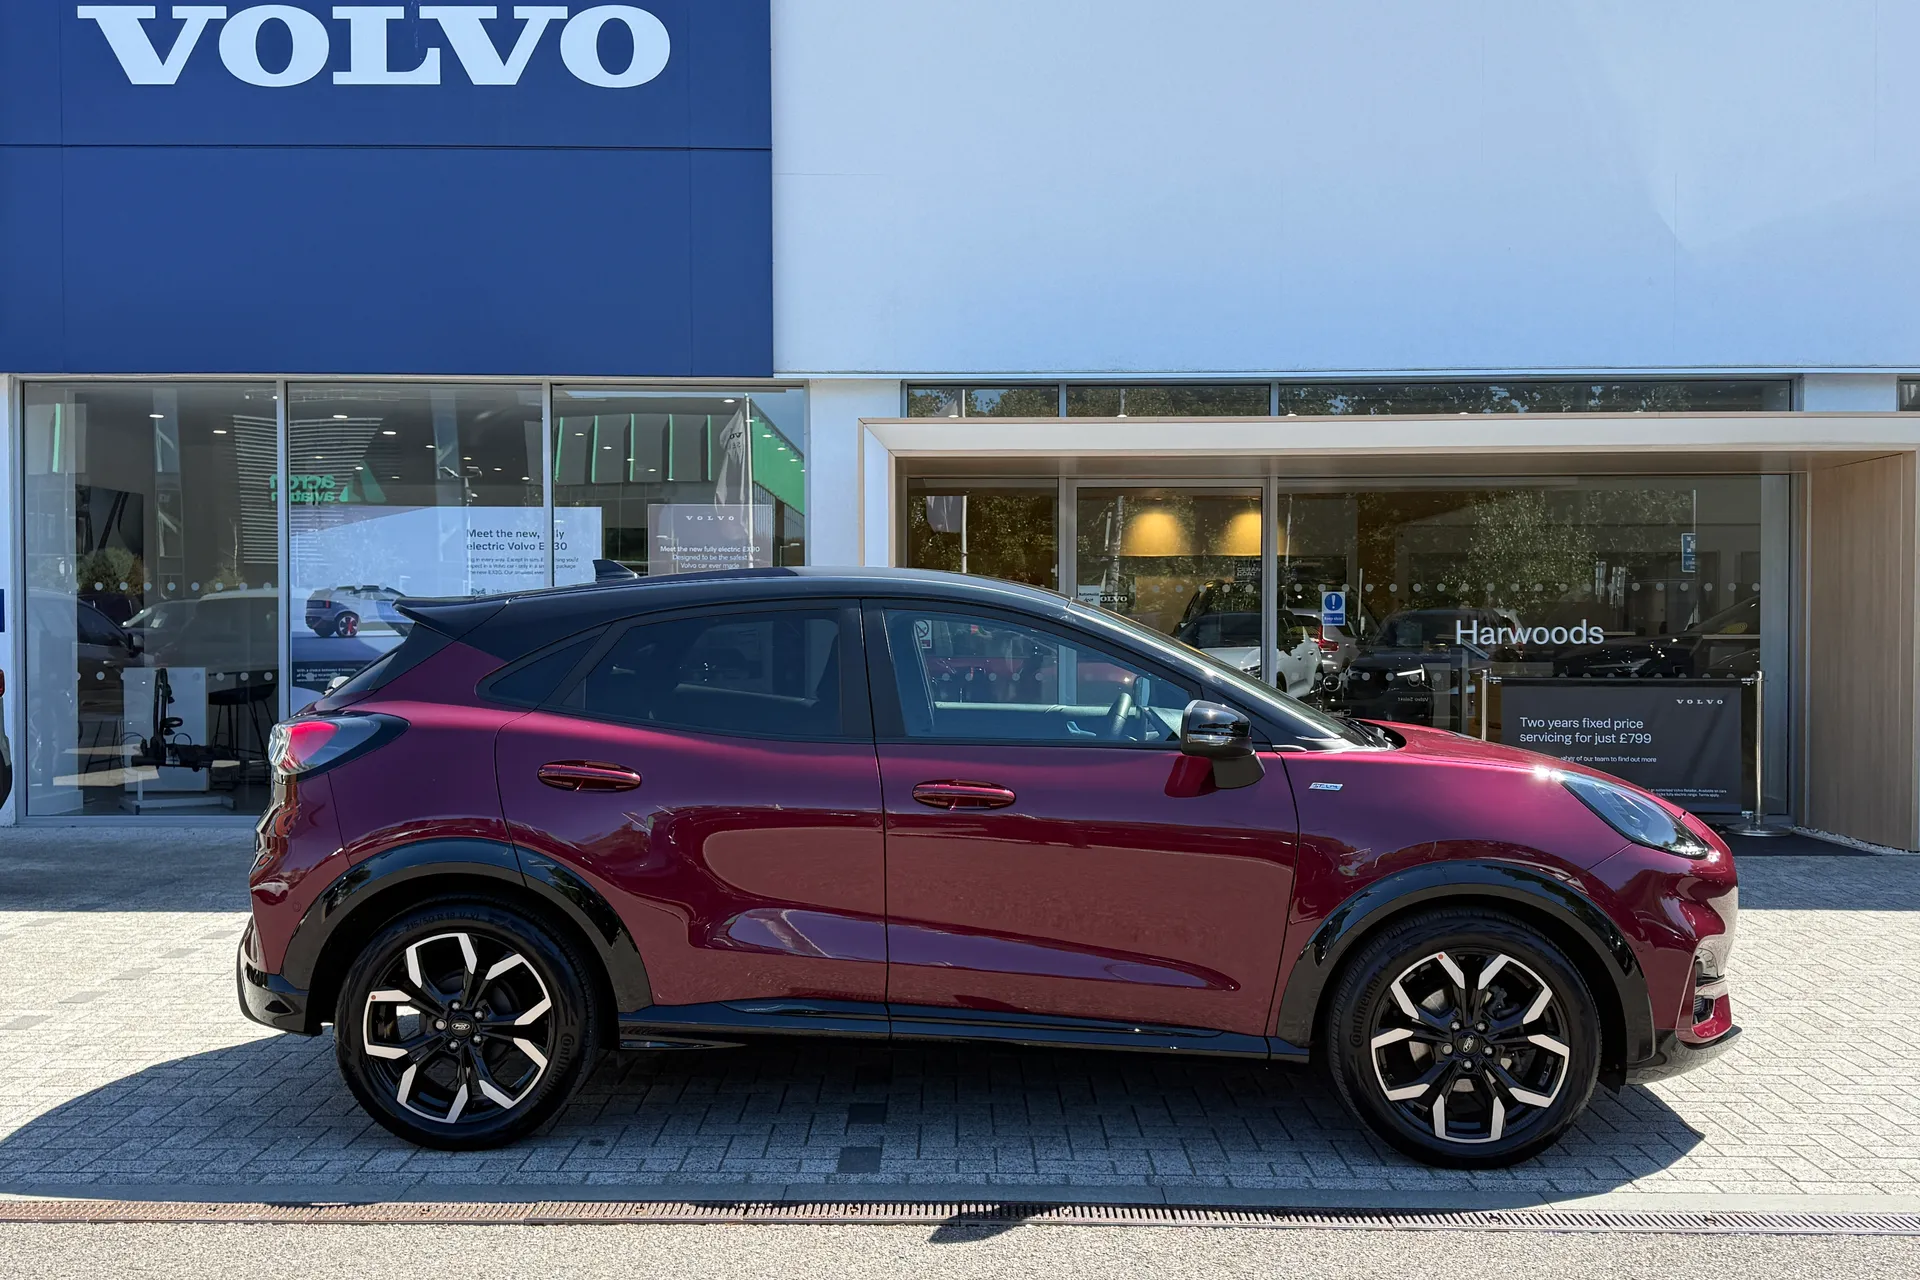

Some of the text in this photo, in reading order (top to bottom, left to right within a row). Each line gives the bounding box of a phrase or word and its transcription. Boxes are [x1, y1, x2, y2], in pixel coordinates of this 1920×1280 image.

[77, 5, 671, 88] VOLVO
[466, 529, 493, 538] Meet
[495, 529, 513, 538] the
[515, 531, 540, 540] new,
[466, 542, 568, 551] electric Volvo E30
[704, 545, 717, 553] fully
[1455, 619, 1605, 645] Harwoods
[1519, 717, 1644, 731] Two years fixed price
[1519, 732, 1652, 746] servicing for just £799
[1349, 974, 1383, 1048] Continental
